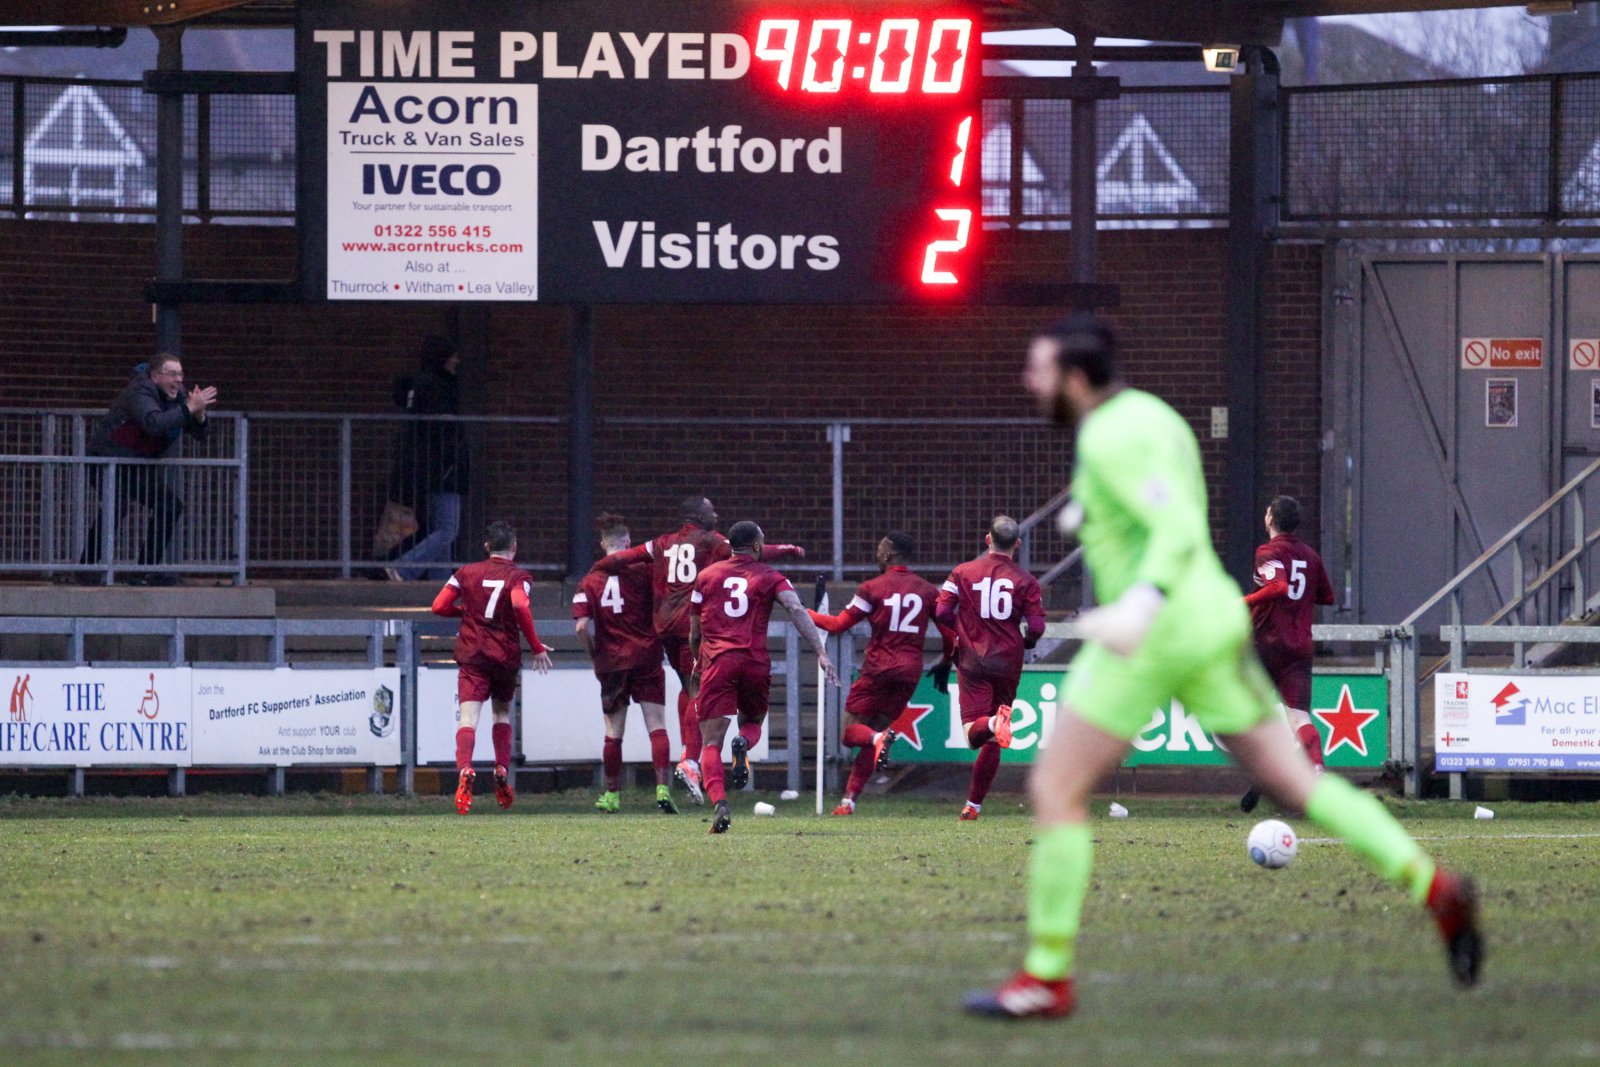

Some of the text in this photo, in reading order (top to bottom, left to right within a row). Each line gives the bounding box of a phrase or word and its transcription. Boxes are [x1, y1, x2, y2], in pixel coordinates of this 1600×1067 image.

[313, 30, 751, 80] TIME PLAYED
[755, 18, 972, 93] 90:00
[349, 85, 518, 124] Acorn
[339, 130, 524, 147] Truck & Van Sales
[581, 124, 842, 174] Dartford
[949, 115, 972, 187] 1
[363, 164, 501, 195] IVECO
[352, 201, 512, 213] Your partner for sustainable transport
[374, 224, 491, 238] 01322 556 415
[592, 220, 840, 271] Visitors
[920, 208, 972, 284] 2
[342, 240, 523, 253] www.acorntrucks.com
[405, 260, 433, 273] Also
[437, 262, 450, 273] at
[331, 280, 534, 296] Thurrock Witham Lea Valley
[1491, 346, 1540, 360] No exit
[664, 543, 697, 583] 18
[601, 575, 625, 614] 4
[1288, 560, 1307, 600] 5
[482, 579, 505, 619] 7
[723, 576, 748, 618] 3
[972, 577, 1015, 620] 16
[883, 593, 922, 633] 12
[63, 683, 106, 711] THE
[198, 685, 224, 696] Join the
[209, 690, 366, 721] Dartford FC Supporters' Association
[1534, 696, 1576, 714] Mac
[100, 722, 188, 751] CENTRE
[278, 726, 357, 738] And support YOUR club
[1541, 726, 1596, 736] For all your
[1552, 738, 1595, 748] Domestic
[259, 745, 357, 757] Ask at the Club Shop for details
[1440, 757, 1463, 766] 01322
